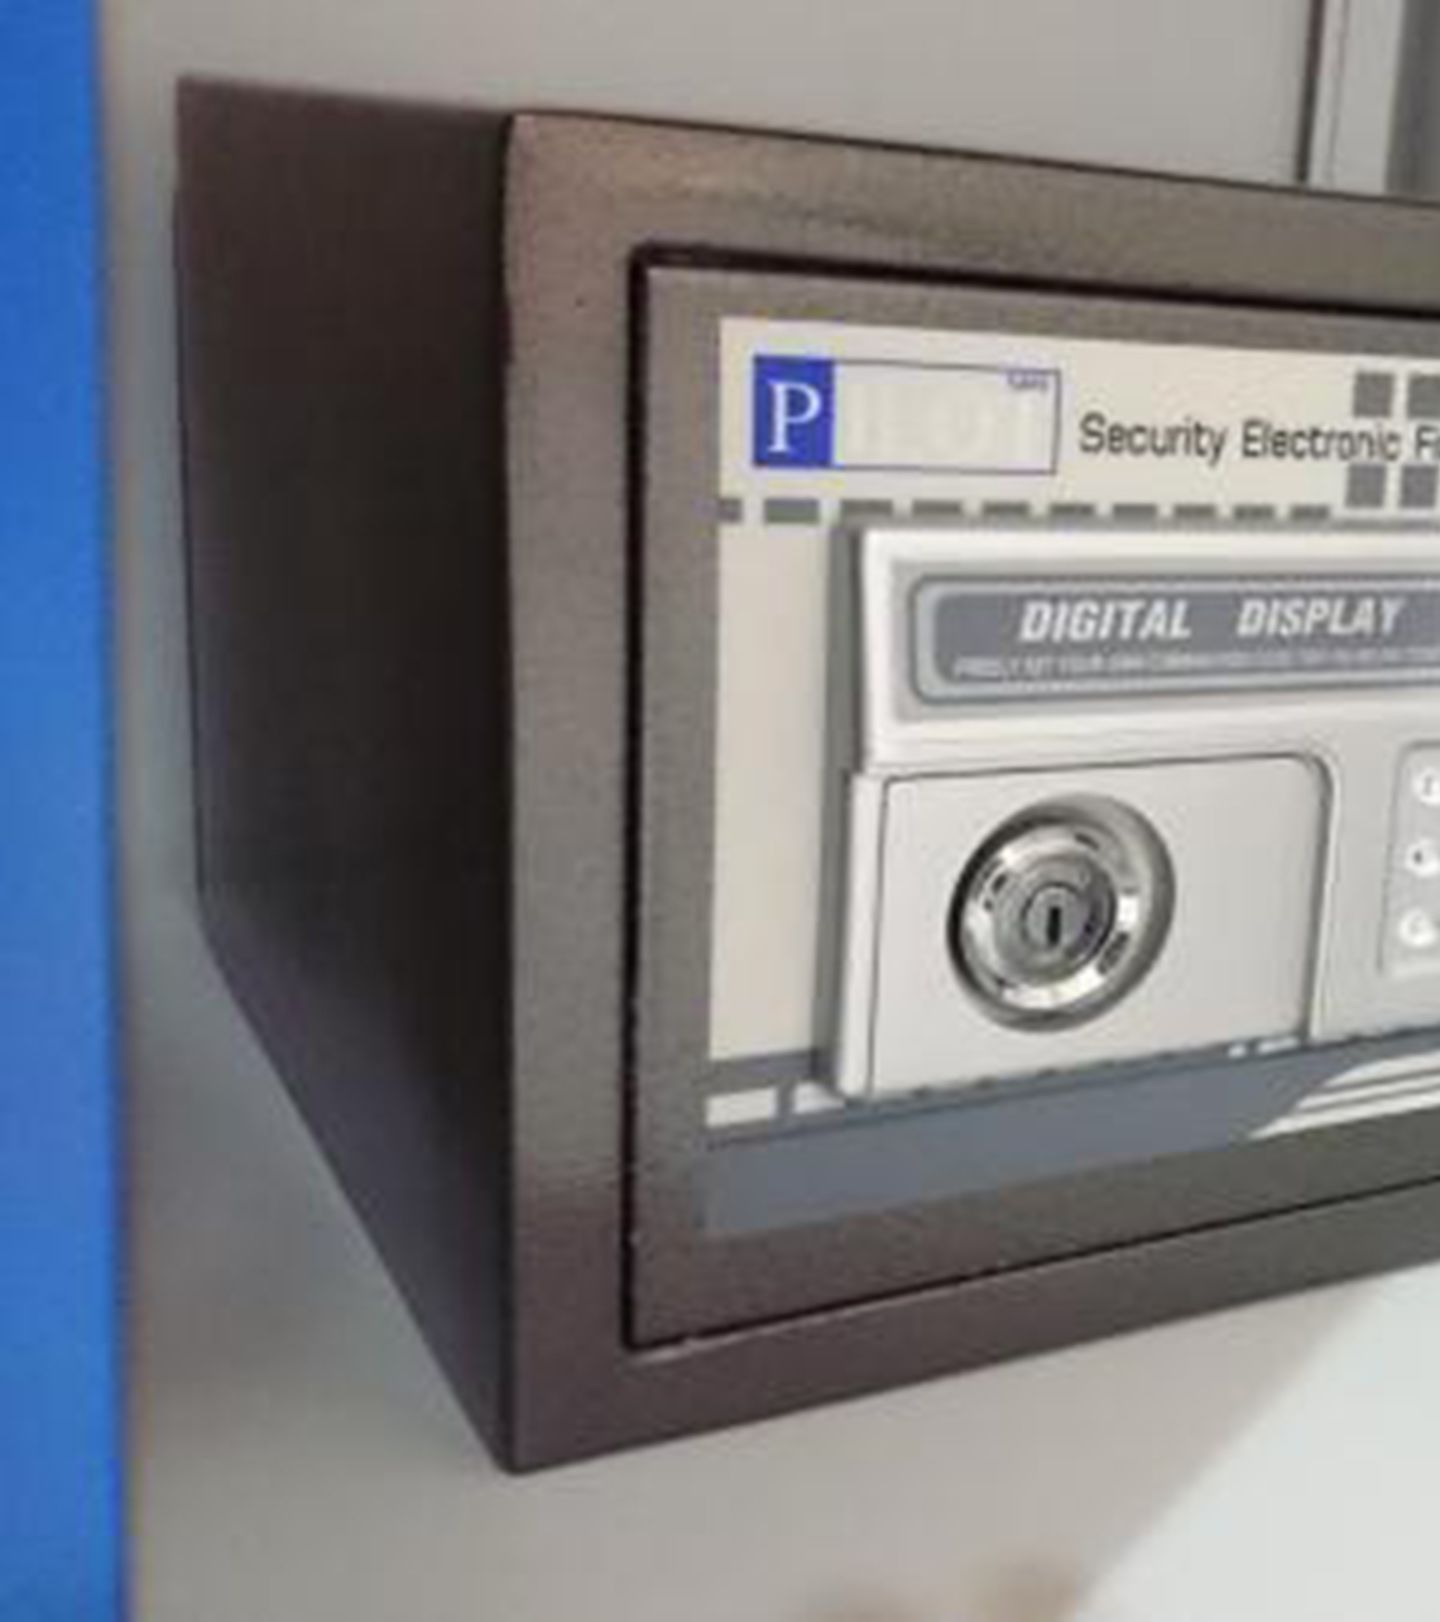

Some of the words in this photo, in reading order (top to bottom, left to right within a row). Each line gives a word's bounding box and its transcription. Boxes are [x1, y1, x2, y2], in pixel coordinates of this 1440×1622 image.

[1079, 411, 1226, 467] Security
[1242, 419, 1401, 461] Electronic
[1019, 599, 1191, 642] DIGITAL
[1236, 598, 1402, 636] DISPLAY
